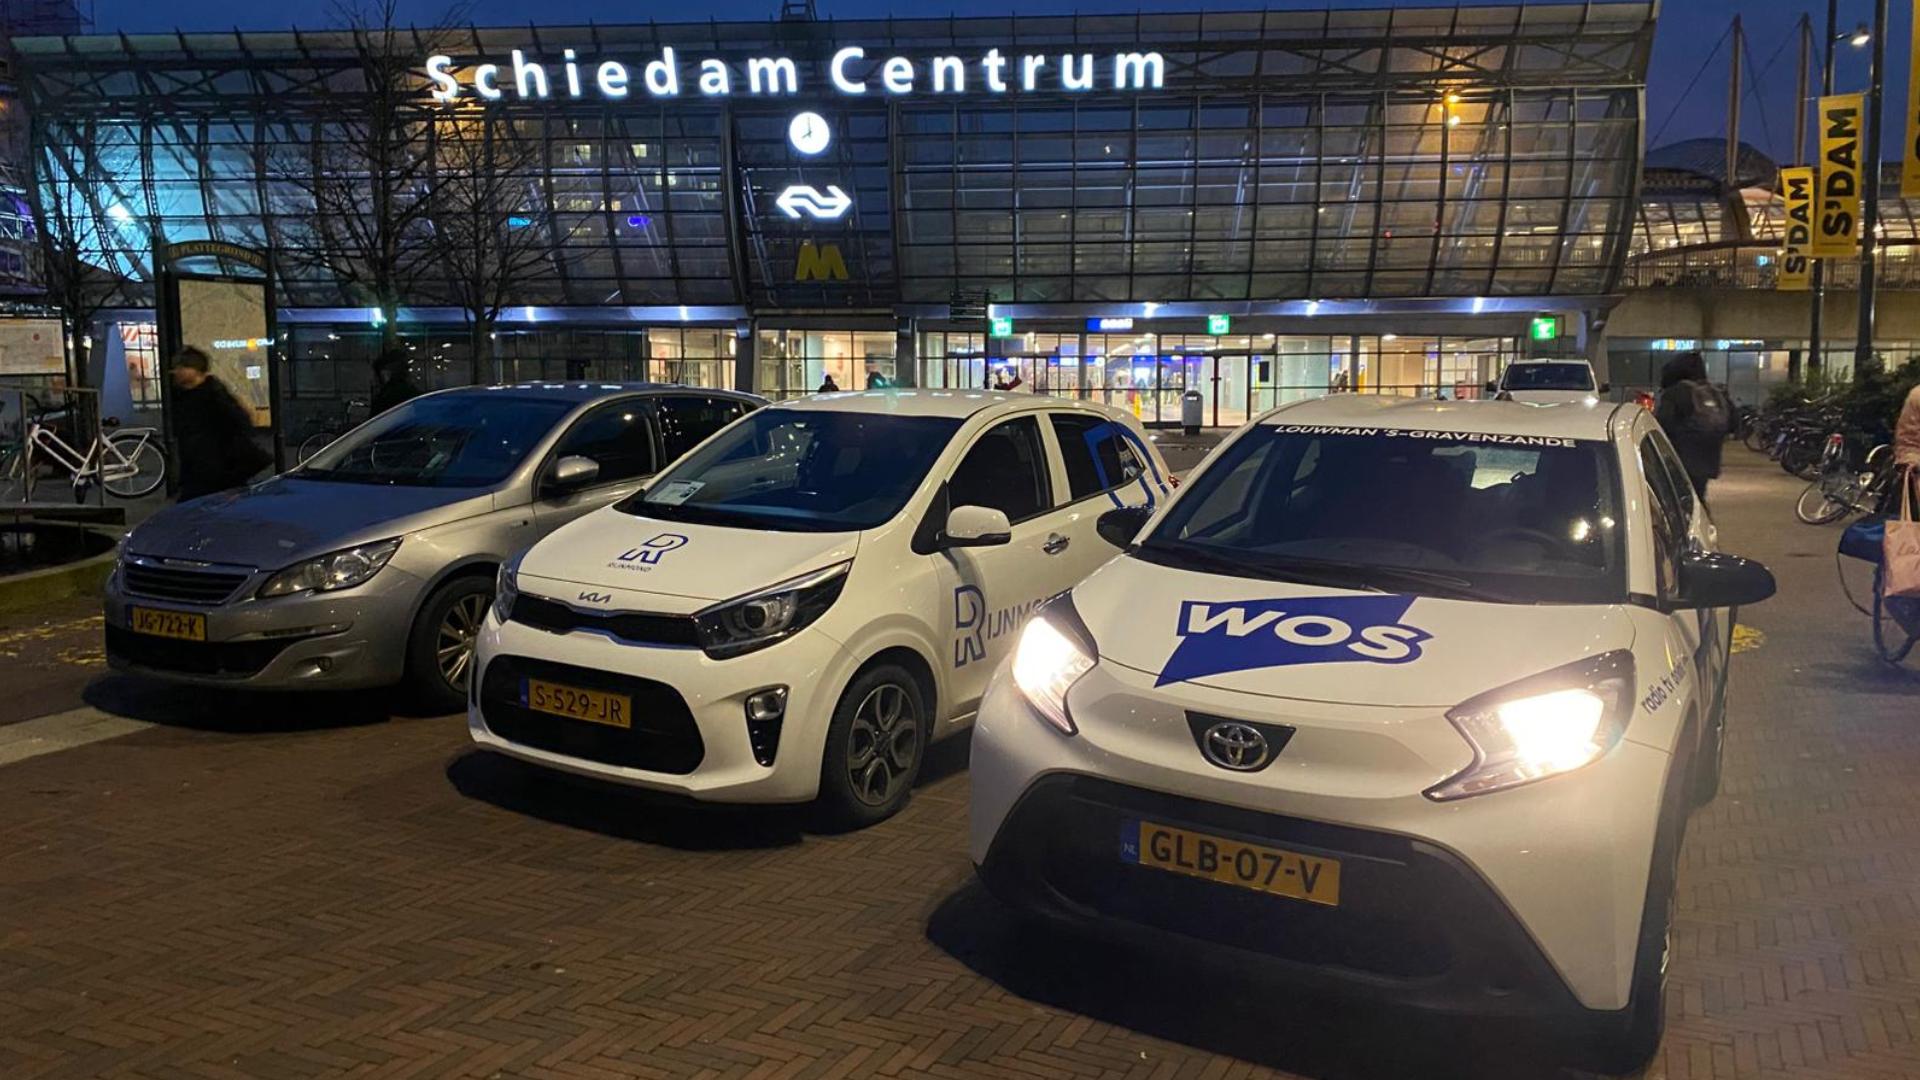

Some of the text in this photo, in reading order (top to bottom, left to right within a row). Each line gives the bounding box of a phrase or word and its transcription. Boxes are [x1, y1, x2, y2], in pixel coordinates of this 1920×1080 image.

[425, 46, 1165, 100] Schiedam Centrum
[1822, 107, 1858, 237] S'DAM
[1785, 177, 1810, 274] S'DAM
[1275, 425, 1577, 449] LOUWMAN 'S-GRAVENZANDE
[137, 610, 198, 637] JG-722-K
[1187, 604, 1418, 660] WOS
[535, 684, 622, 721] S-529-JR
[1641, 684, 1667, 715] radio
[1150, 830, 1323, 894] GLB-07-V
